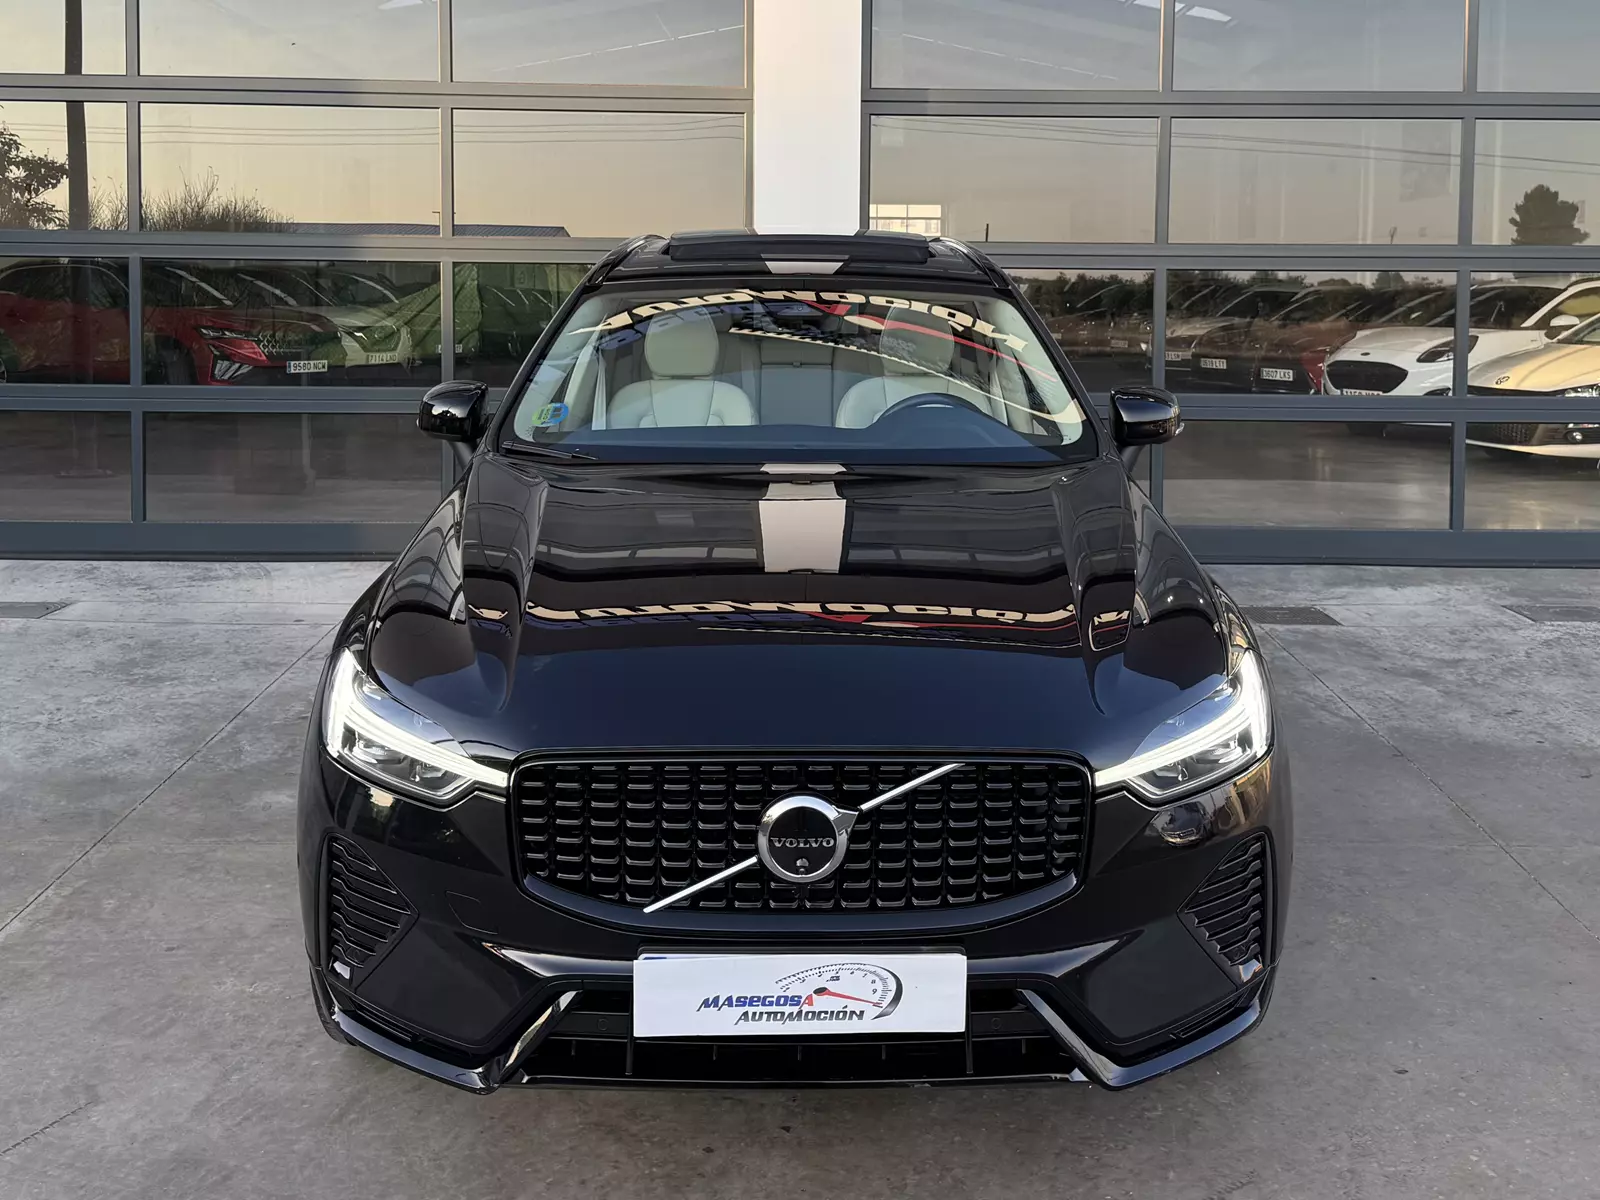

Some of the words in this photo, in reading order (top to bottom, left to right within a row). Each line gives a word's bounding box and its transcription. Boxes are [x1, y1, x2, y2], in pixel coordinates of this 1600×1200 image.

[292, 362, 312, 371] 9580
[1264, 369, 1278, 378] 3607
[770, 837, 835, 848] VOLVO
[696, 993, 815, 1011] MASEGOSA
[734, 1005, 865, 1025] AUTOMOCIÓN
